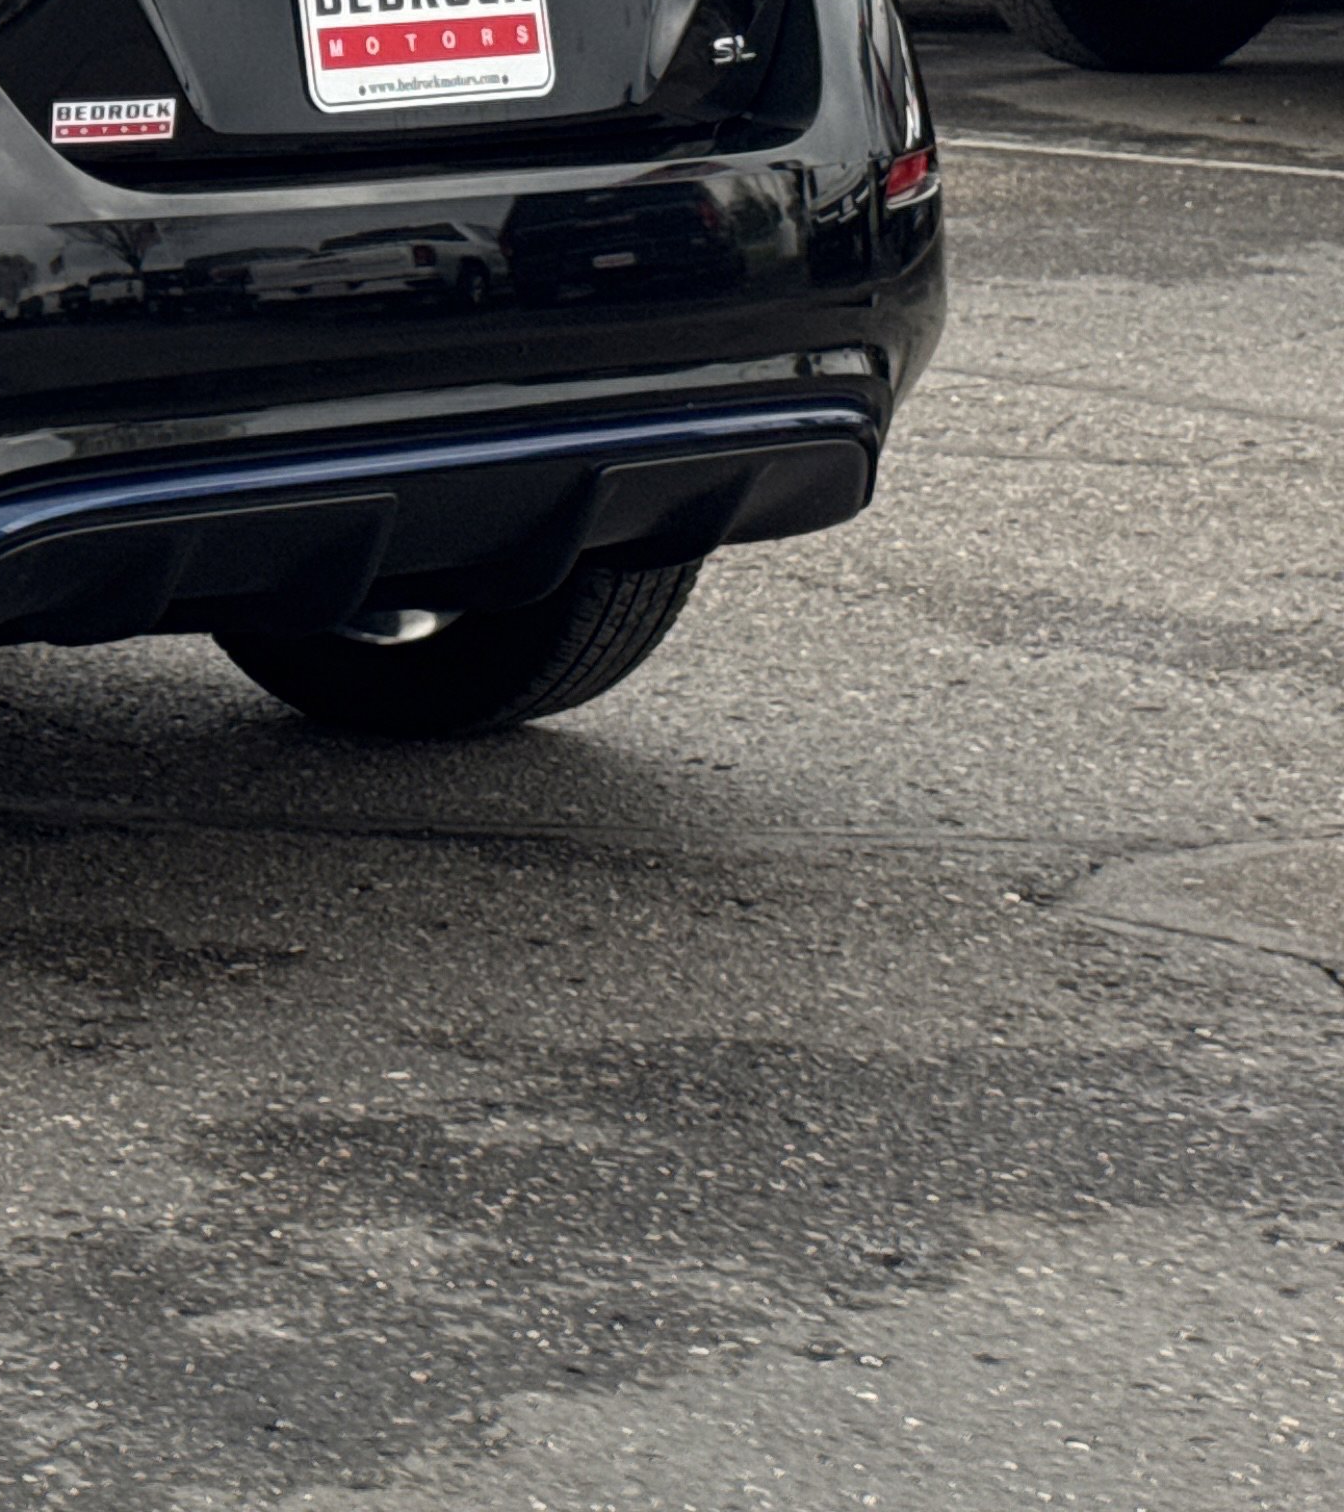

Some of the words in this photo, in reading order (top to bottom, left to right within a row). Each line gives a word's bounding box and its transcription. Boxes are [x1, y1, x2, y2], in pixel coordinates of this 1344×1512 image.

[328, 24, 530, 58] MOTORS
[713, 35, 757, 65] SL
[368, 73, 501, 94] www.bedrockmotors.com
[56, 102, 171, 121] BEDROCK
